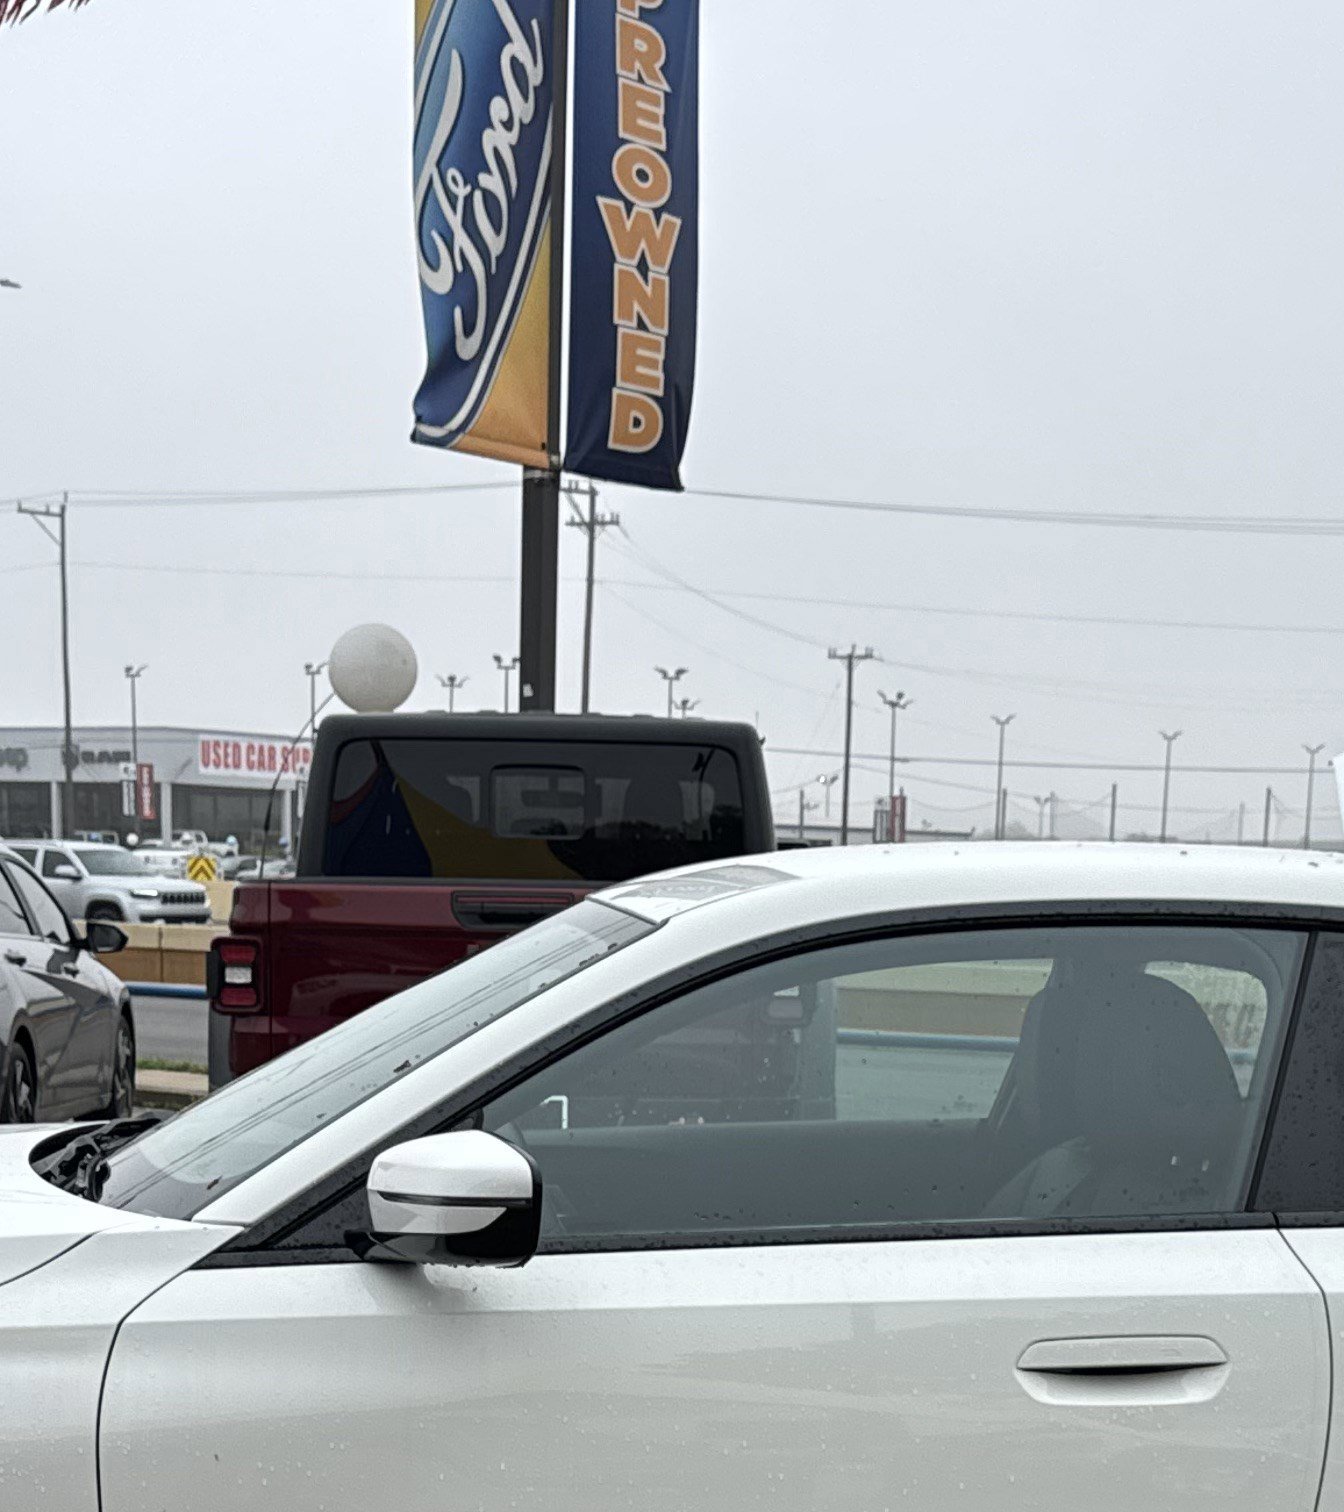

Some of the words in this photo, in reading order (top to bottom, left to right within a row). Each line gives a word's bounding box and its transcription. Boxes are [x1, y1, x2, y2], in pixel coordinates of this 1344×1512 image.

[416, 0, 544, 361] Ford
[201, 739, 241, 770] USED
[246, 742, 277, 772] CAR
